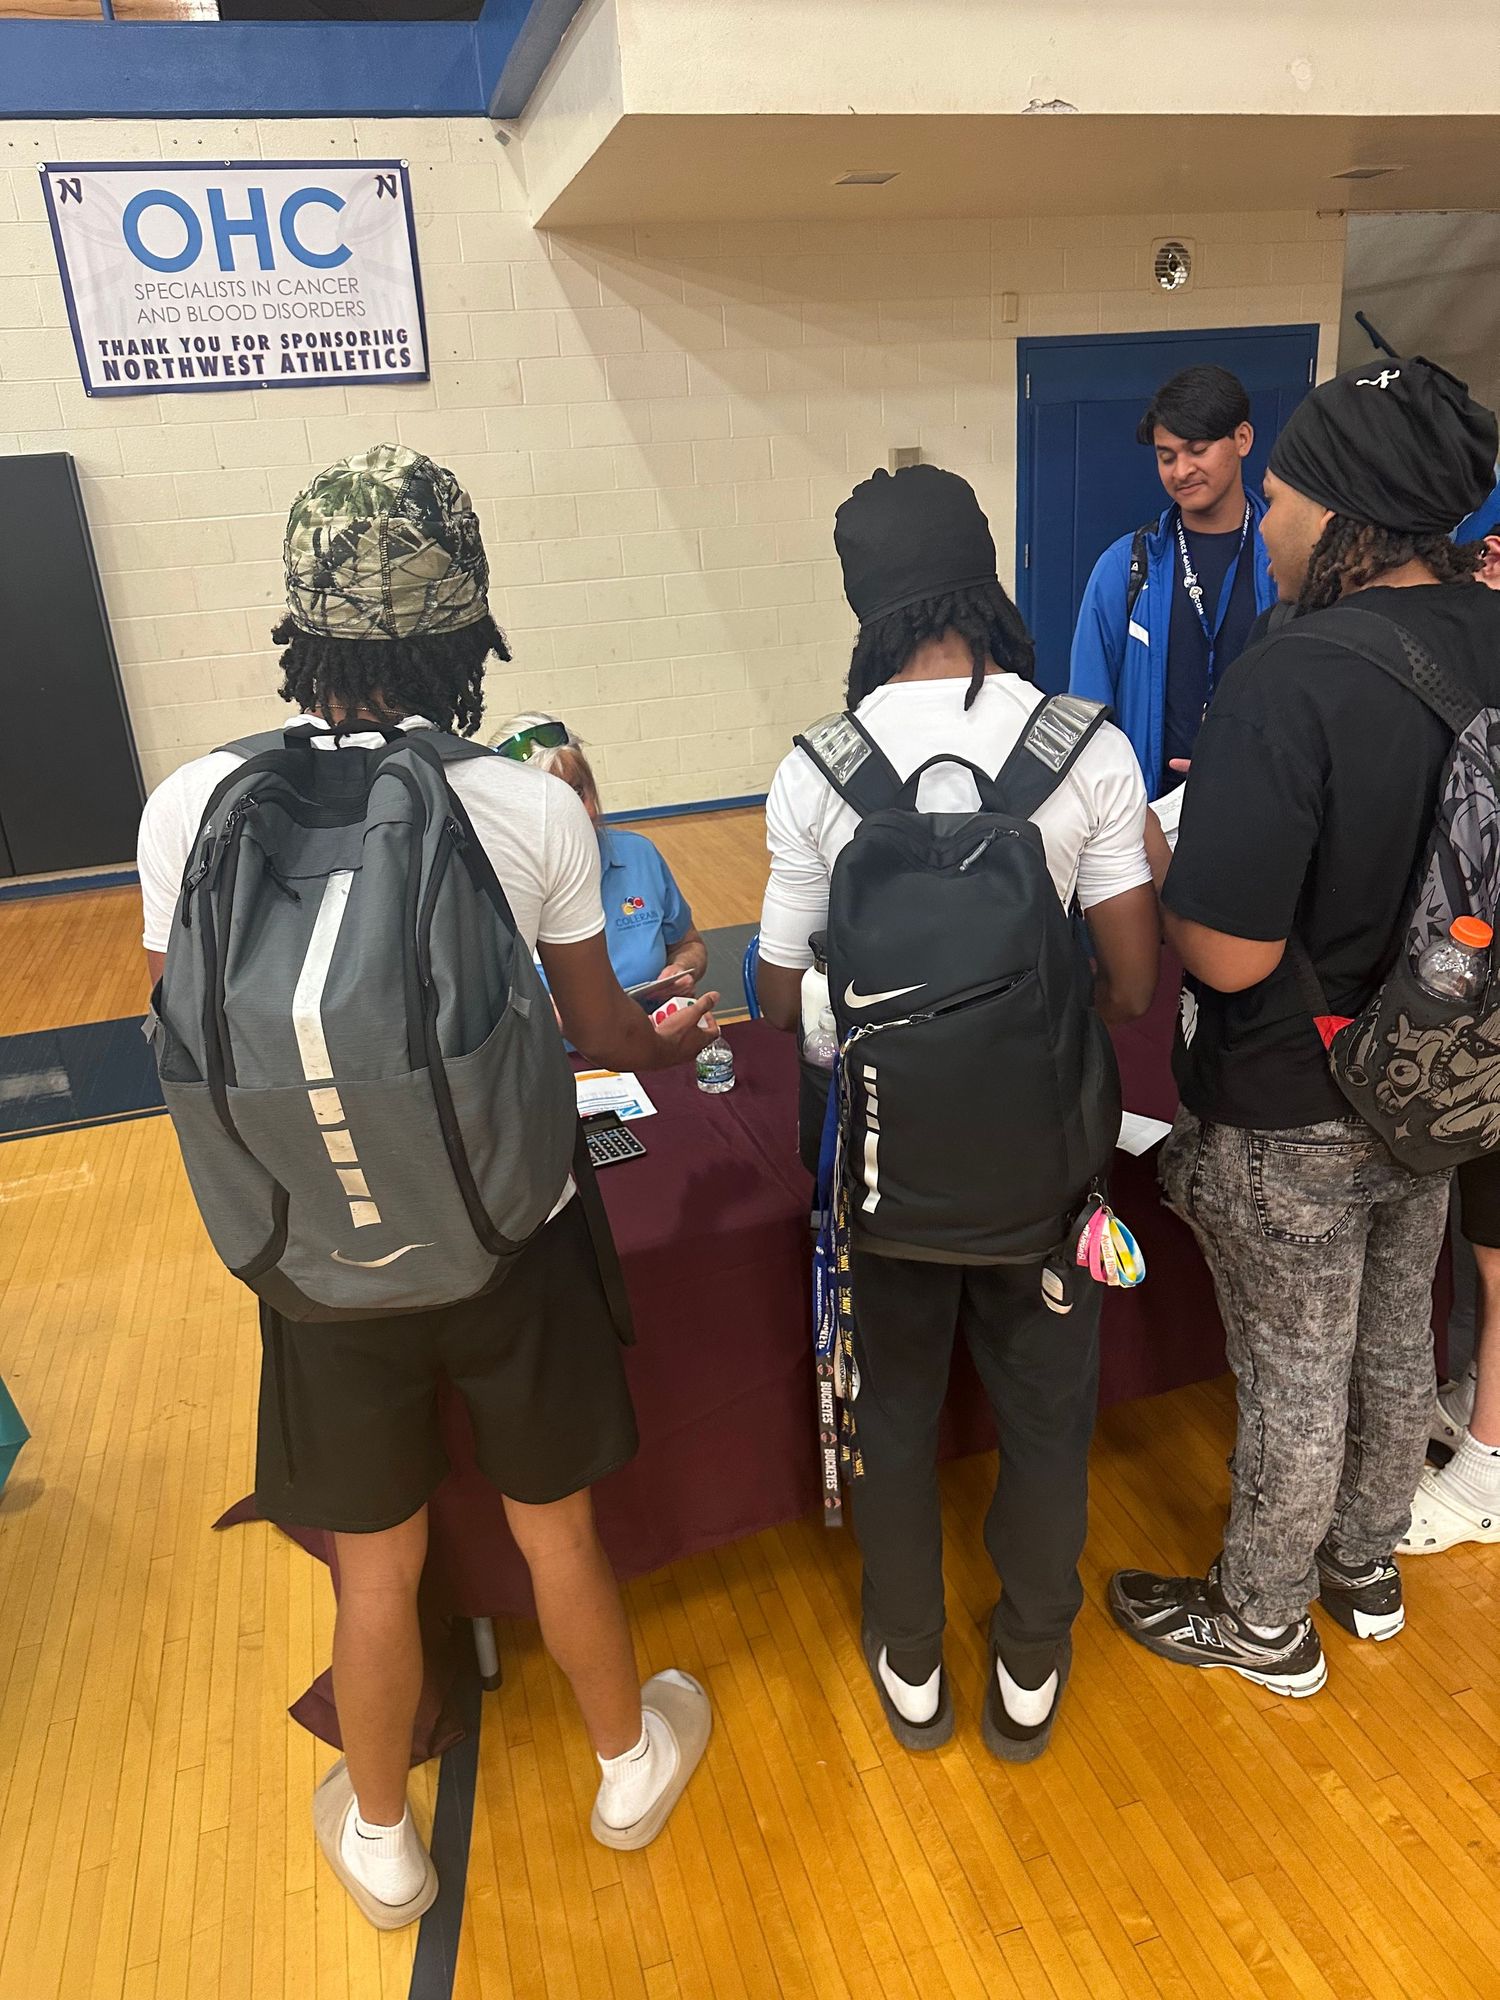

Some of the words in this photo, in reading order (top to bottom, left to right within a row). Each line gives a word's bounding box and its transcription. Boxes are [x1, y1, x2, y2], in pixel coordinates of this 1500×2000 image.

[56, 177, 83, 204] N
[373, 174, 398, 200] N
[122, 186, 353, 273] OHC
[134, 280, 246, 301] SPECIALISTS
[251, 279, 271, 297] IN
[277, 277, 360, 296] CANCER
[136, 305, 181, 325] AND
[188, 303, 257, 322] BLOOD
[264, 300, 366, 320] DISORDERS
[98, 336, 171, 357] THANK
[179, 335, 224, 354] YOU
[232, 333, 271, 351] FOR
[280, 328, 409, 350] SPONSORING
[103, 354, 267, 381] NORTHWEST
[280, 347, 412, 374] ATHLETICS
[1178, 530, 1188, 554] FORCE
[1101, 1234, 1114, 1259] Avoid
[840, 1254, 850, 1272] NAVY
[842, 1297, 852, 1315] NAVY
[845, 1339, 853, 1357] NAVY
[820, 1381, 833, 1424] BUCKEYES
[824, 1448, 837, 1490] BUCKEYES
[1187, 1614, 1224, 1648] N
